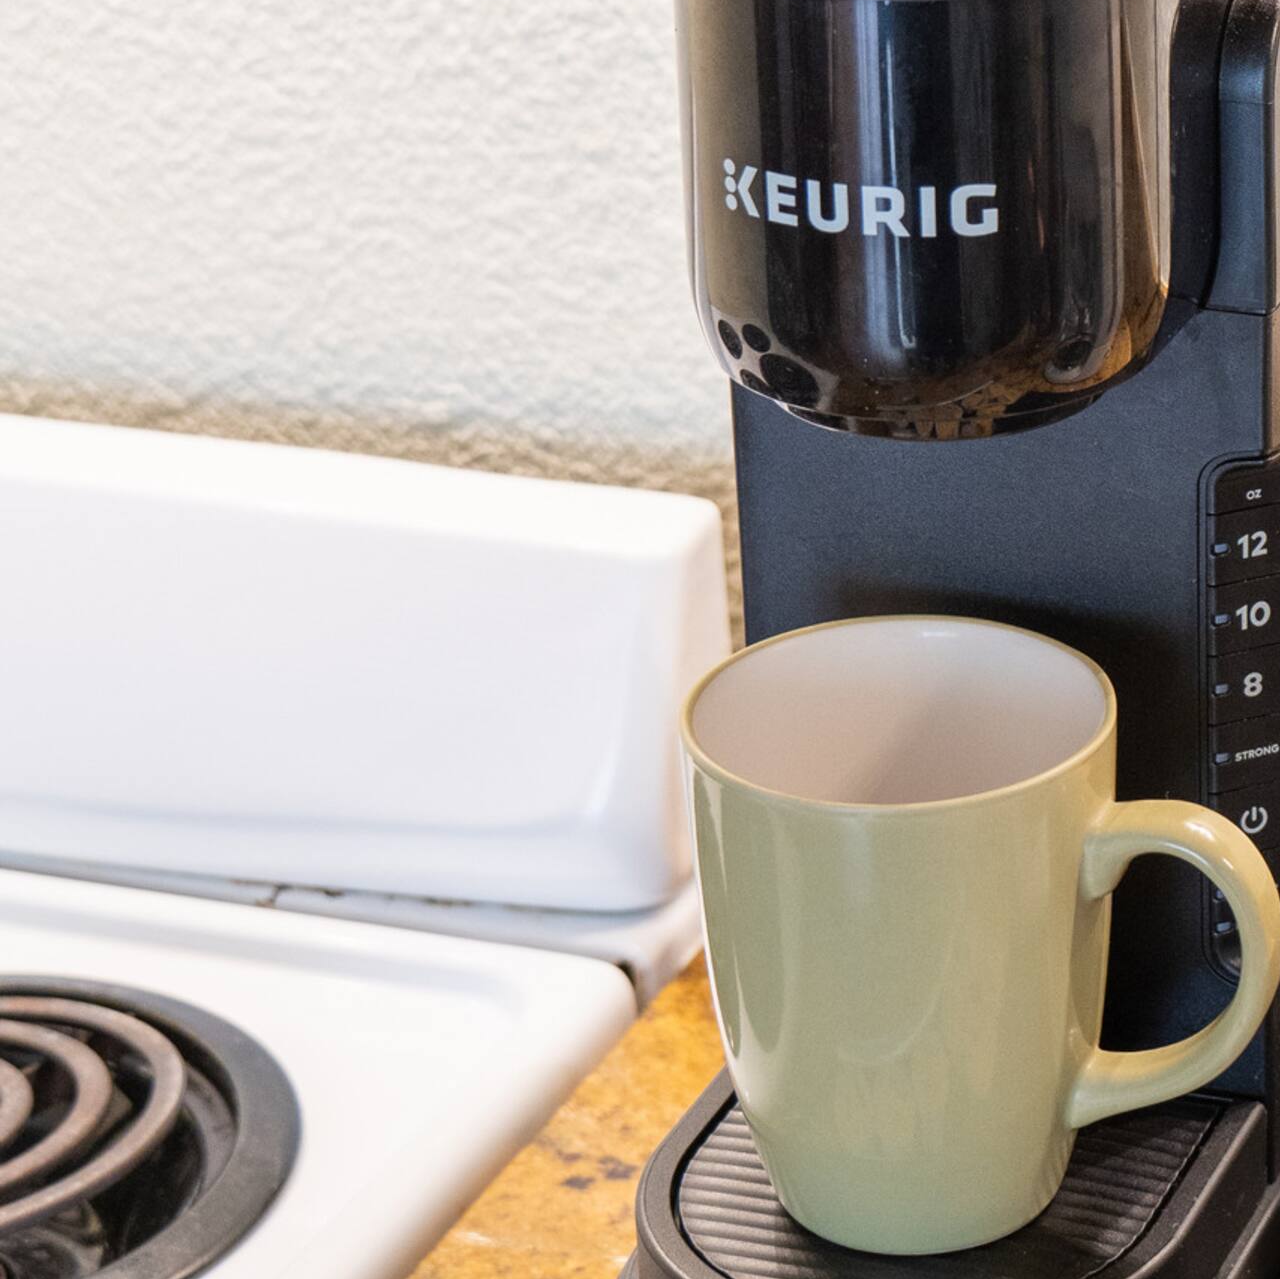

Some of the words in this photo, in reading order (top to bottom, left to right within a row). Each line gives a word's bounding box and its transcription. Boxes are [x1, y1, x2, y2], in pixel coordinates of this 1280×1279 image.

[723, 158, 999, 238] KEURIG
[1236, 530, 1269, 560] 12
[1235, 601, 1271, 631] 10
[1243, 672, 1264, 698] 8
[1234, 743, 1280, 763] STRONG
